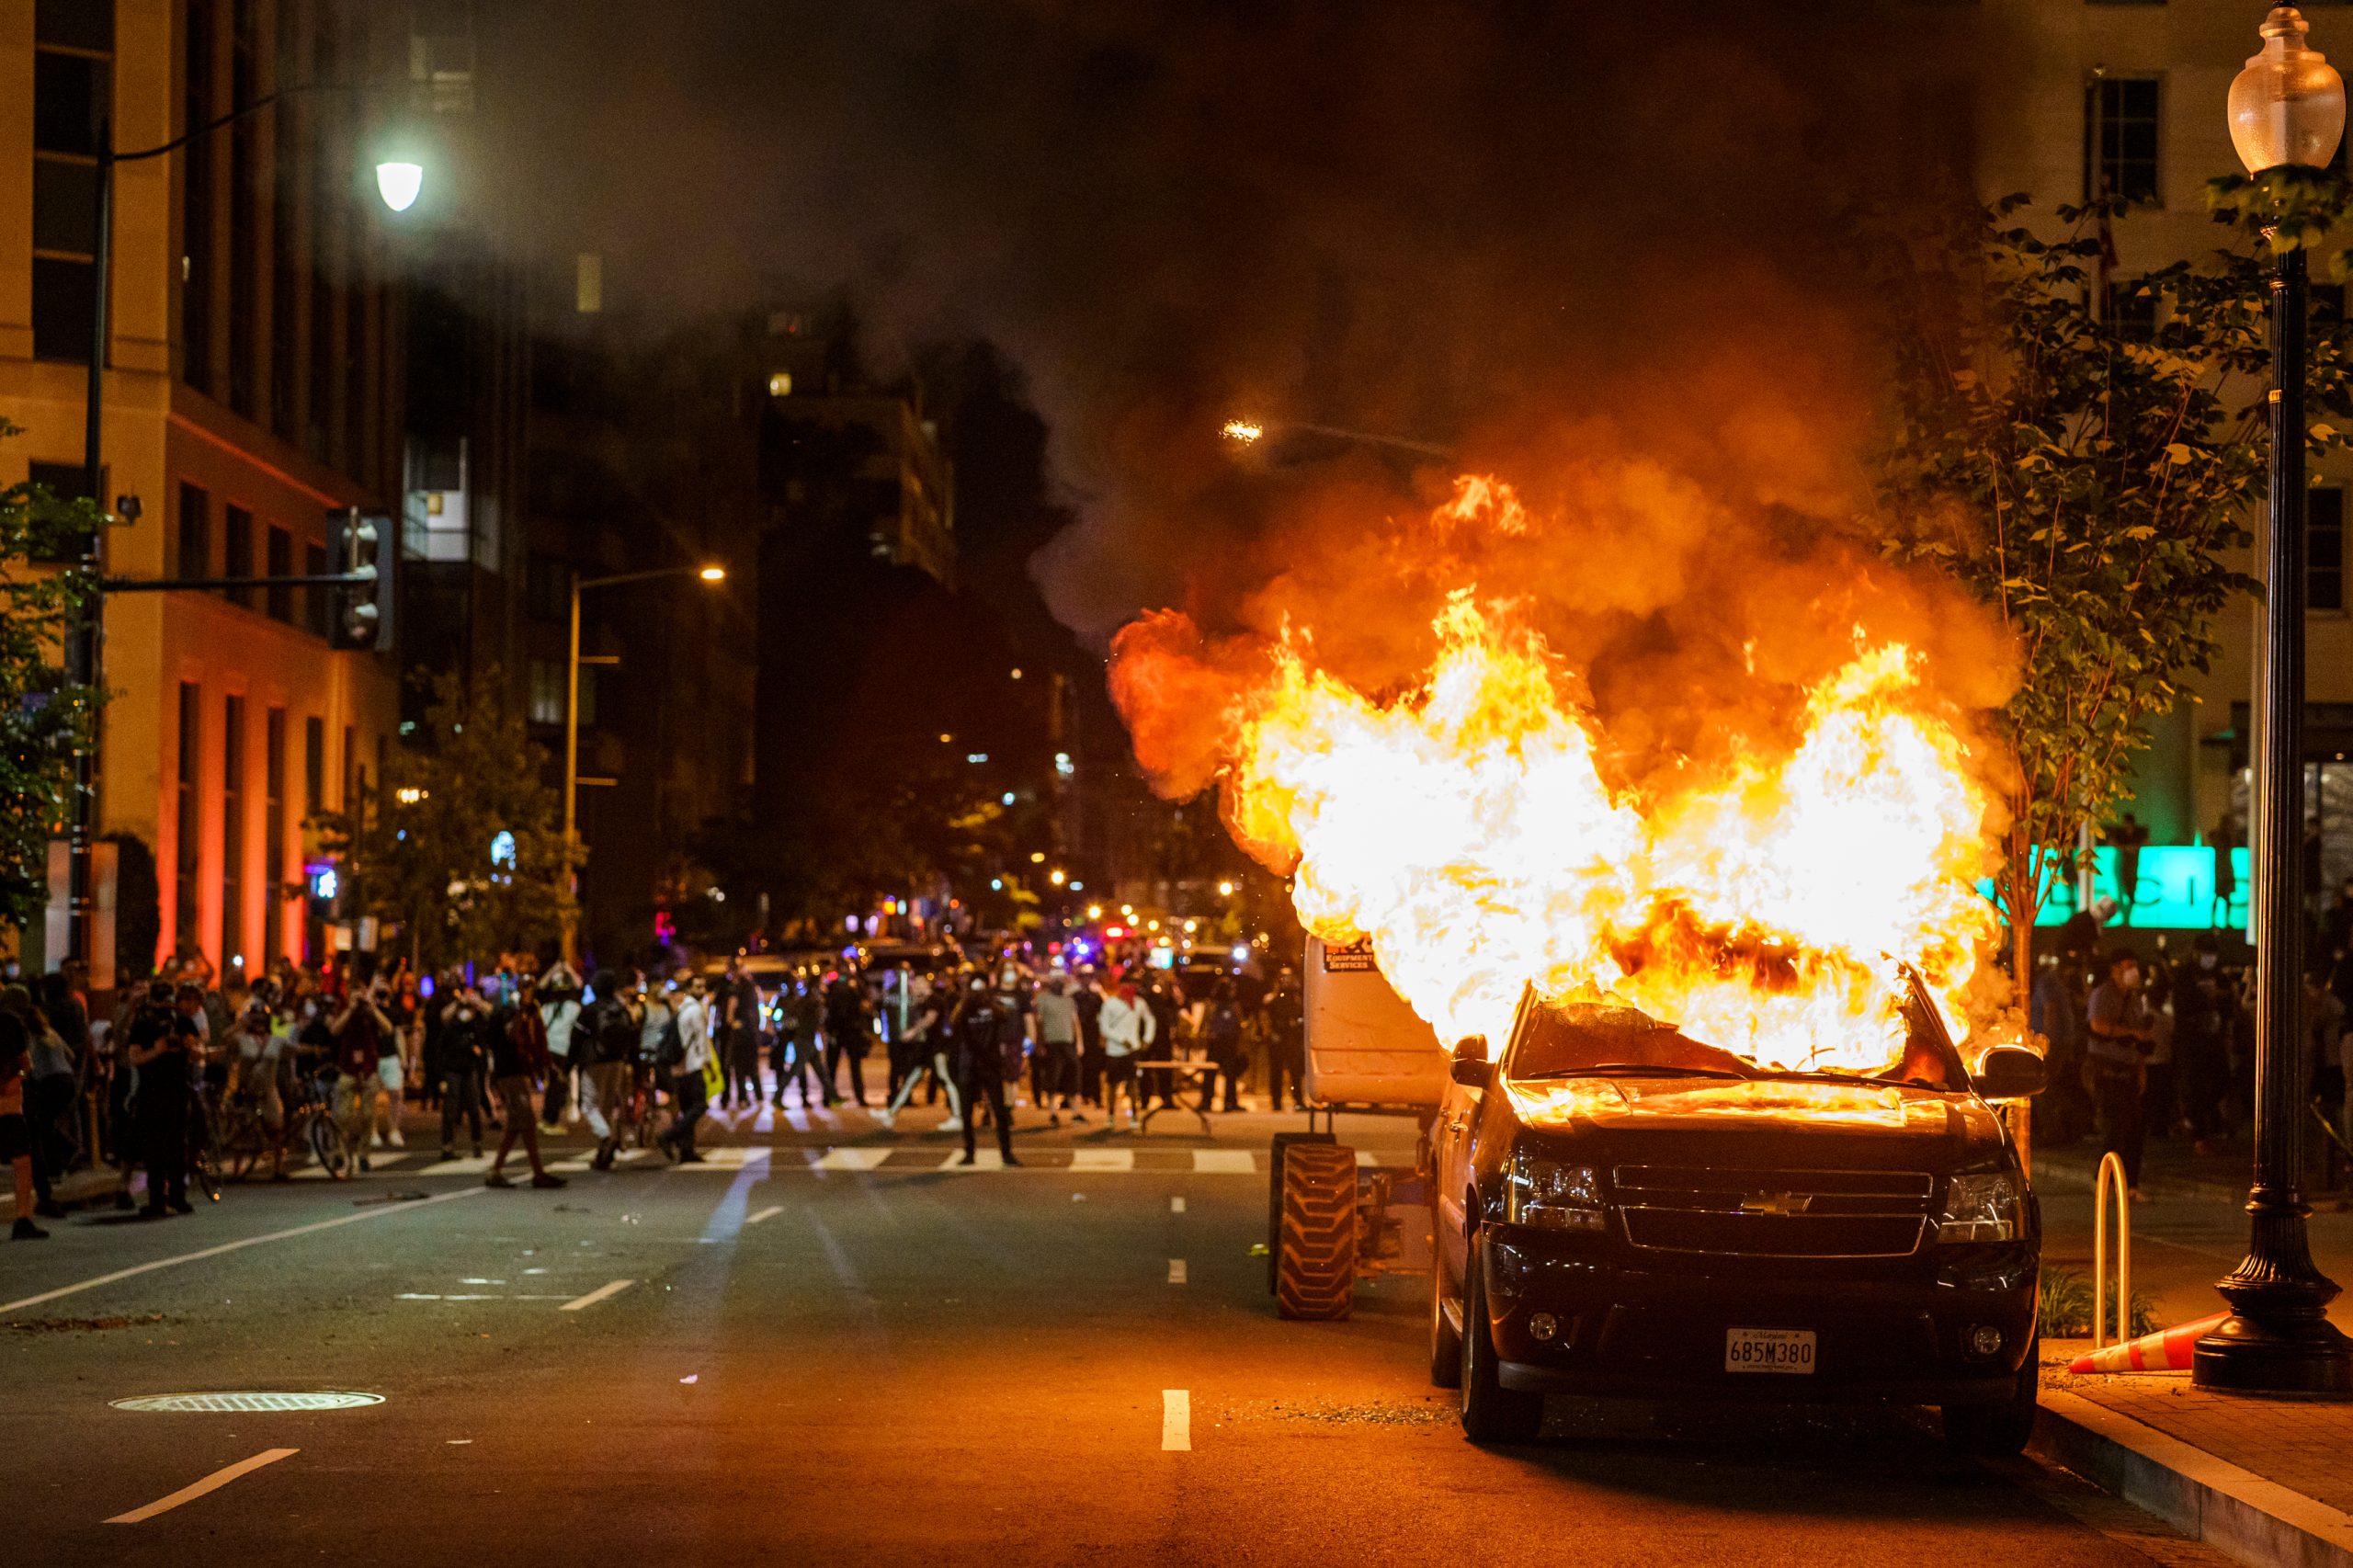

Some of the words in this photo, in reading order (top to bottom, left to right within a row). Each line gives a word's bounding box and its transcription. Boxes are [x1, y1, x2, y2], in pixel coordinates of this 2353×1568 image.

[1326, 954, 1373, 962] EQUIPMENT
[1329, 961, 1369, 970] SERVICES
[1731, 1341, 1811, 1363] 685M380
